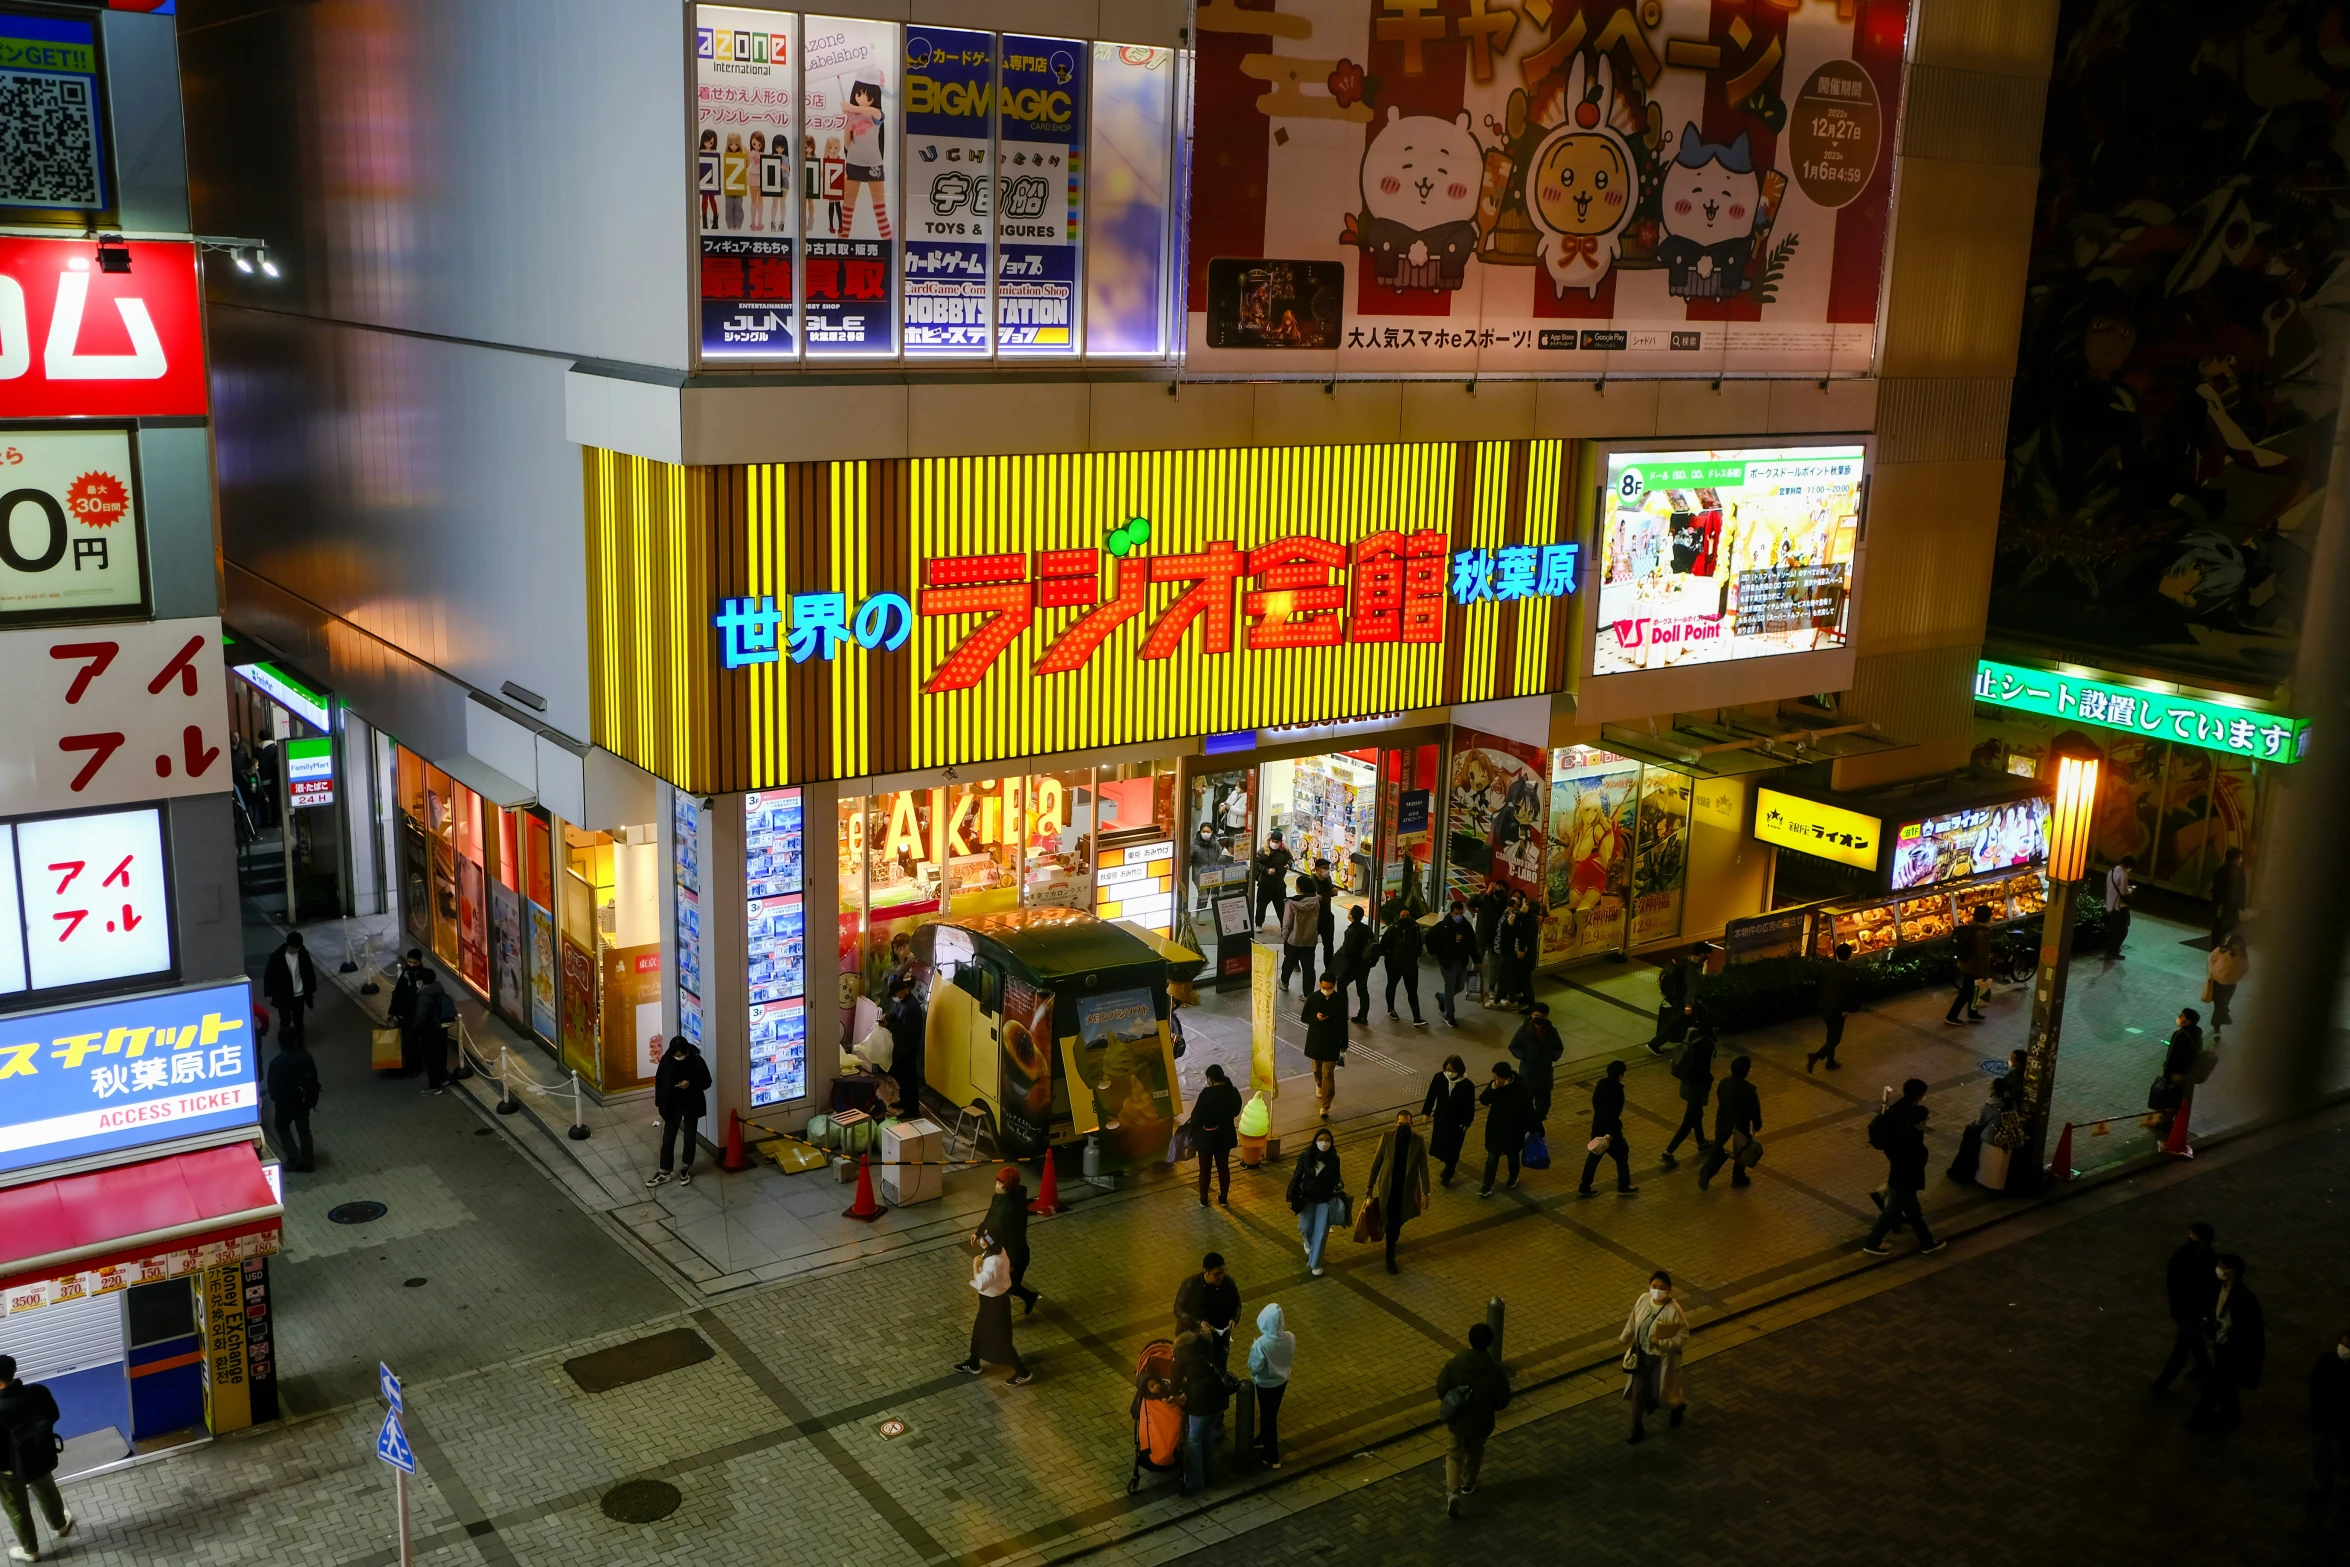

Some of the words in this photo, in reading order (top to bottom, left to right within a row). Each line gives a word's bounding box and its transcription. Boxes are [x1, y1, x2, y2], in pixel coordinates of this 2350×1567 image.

[713, 62, 771, 76] International
[1818, 76, 1864, 98] 開催期間
[1030, 122, 1050, 131] CARD
[1051, 124, 1072, 132] SHOP
[1812, 117, 1862, 141] 12月27日
[925, 222, 966, 235] TOYS
[972, 225, 983, 235] &
[1001, 225, 1055, 238] IGURES
[1044, 285, 1069, 298] Shop
[0, 272, 168, 380] ム
[724, 332, 769, 342] ジャングル
[1550, 334, 1561, 342] App
[1562, 334, 1575, 342] Store
[1594, 333, 1613, 342] Google
[1614, 333, 1625, 343] Play
[1682, 335, 1697, 348] 検索
[87, 485, 107, 495] 最大
[1621, 474, 1643, 496] 8F
[76, 498, 121, 513] 30日間
[1448, 543, 1580, 606] 秋葉原
[917, 518, 1448, 695] ラジオ会館
[711, 591, 912, 670] 世界の
[1652, 624, 1681, 645] Doll
[1684, 620, 1721, 642] Point
[50, 635, 205, 704] アイ
[59, 725, 220, 792] フル
[291, 761, 330, 772] FamilyMart
[299, 796, 314, 804] 24
[749, 796, 760, 805] 3F
[1789, 820, 1869, 850] 銀座ライオン
[48, 855, 134, 896] アイ
[1509, 864, 1538, 884] C-LABO
[750, 902, 762, 912] 3F
[52, 904, 142, 943] フル
[1632, 917, 1652, 935] 12.9
[1580, 930, 1600, 946] 12.9
[753, 1008, 764, 1017] 3F
[91, 1045, 242, 1099] 秋葉原店
[98, 1103, 171, 1129] ACCESS
[178, 1089, 242, 1114] TICKET
[245, 1271, 263, 1282] USD
[253, 1335, 265, 1343] EUR
